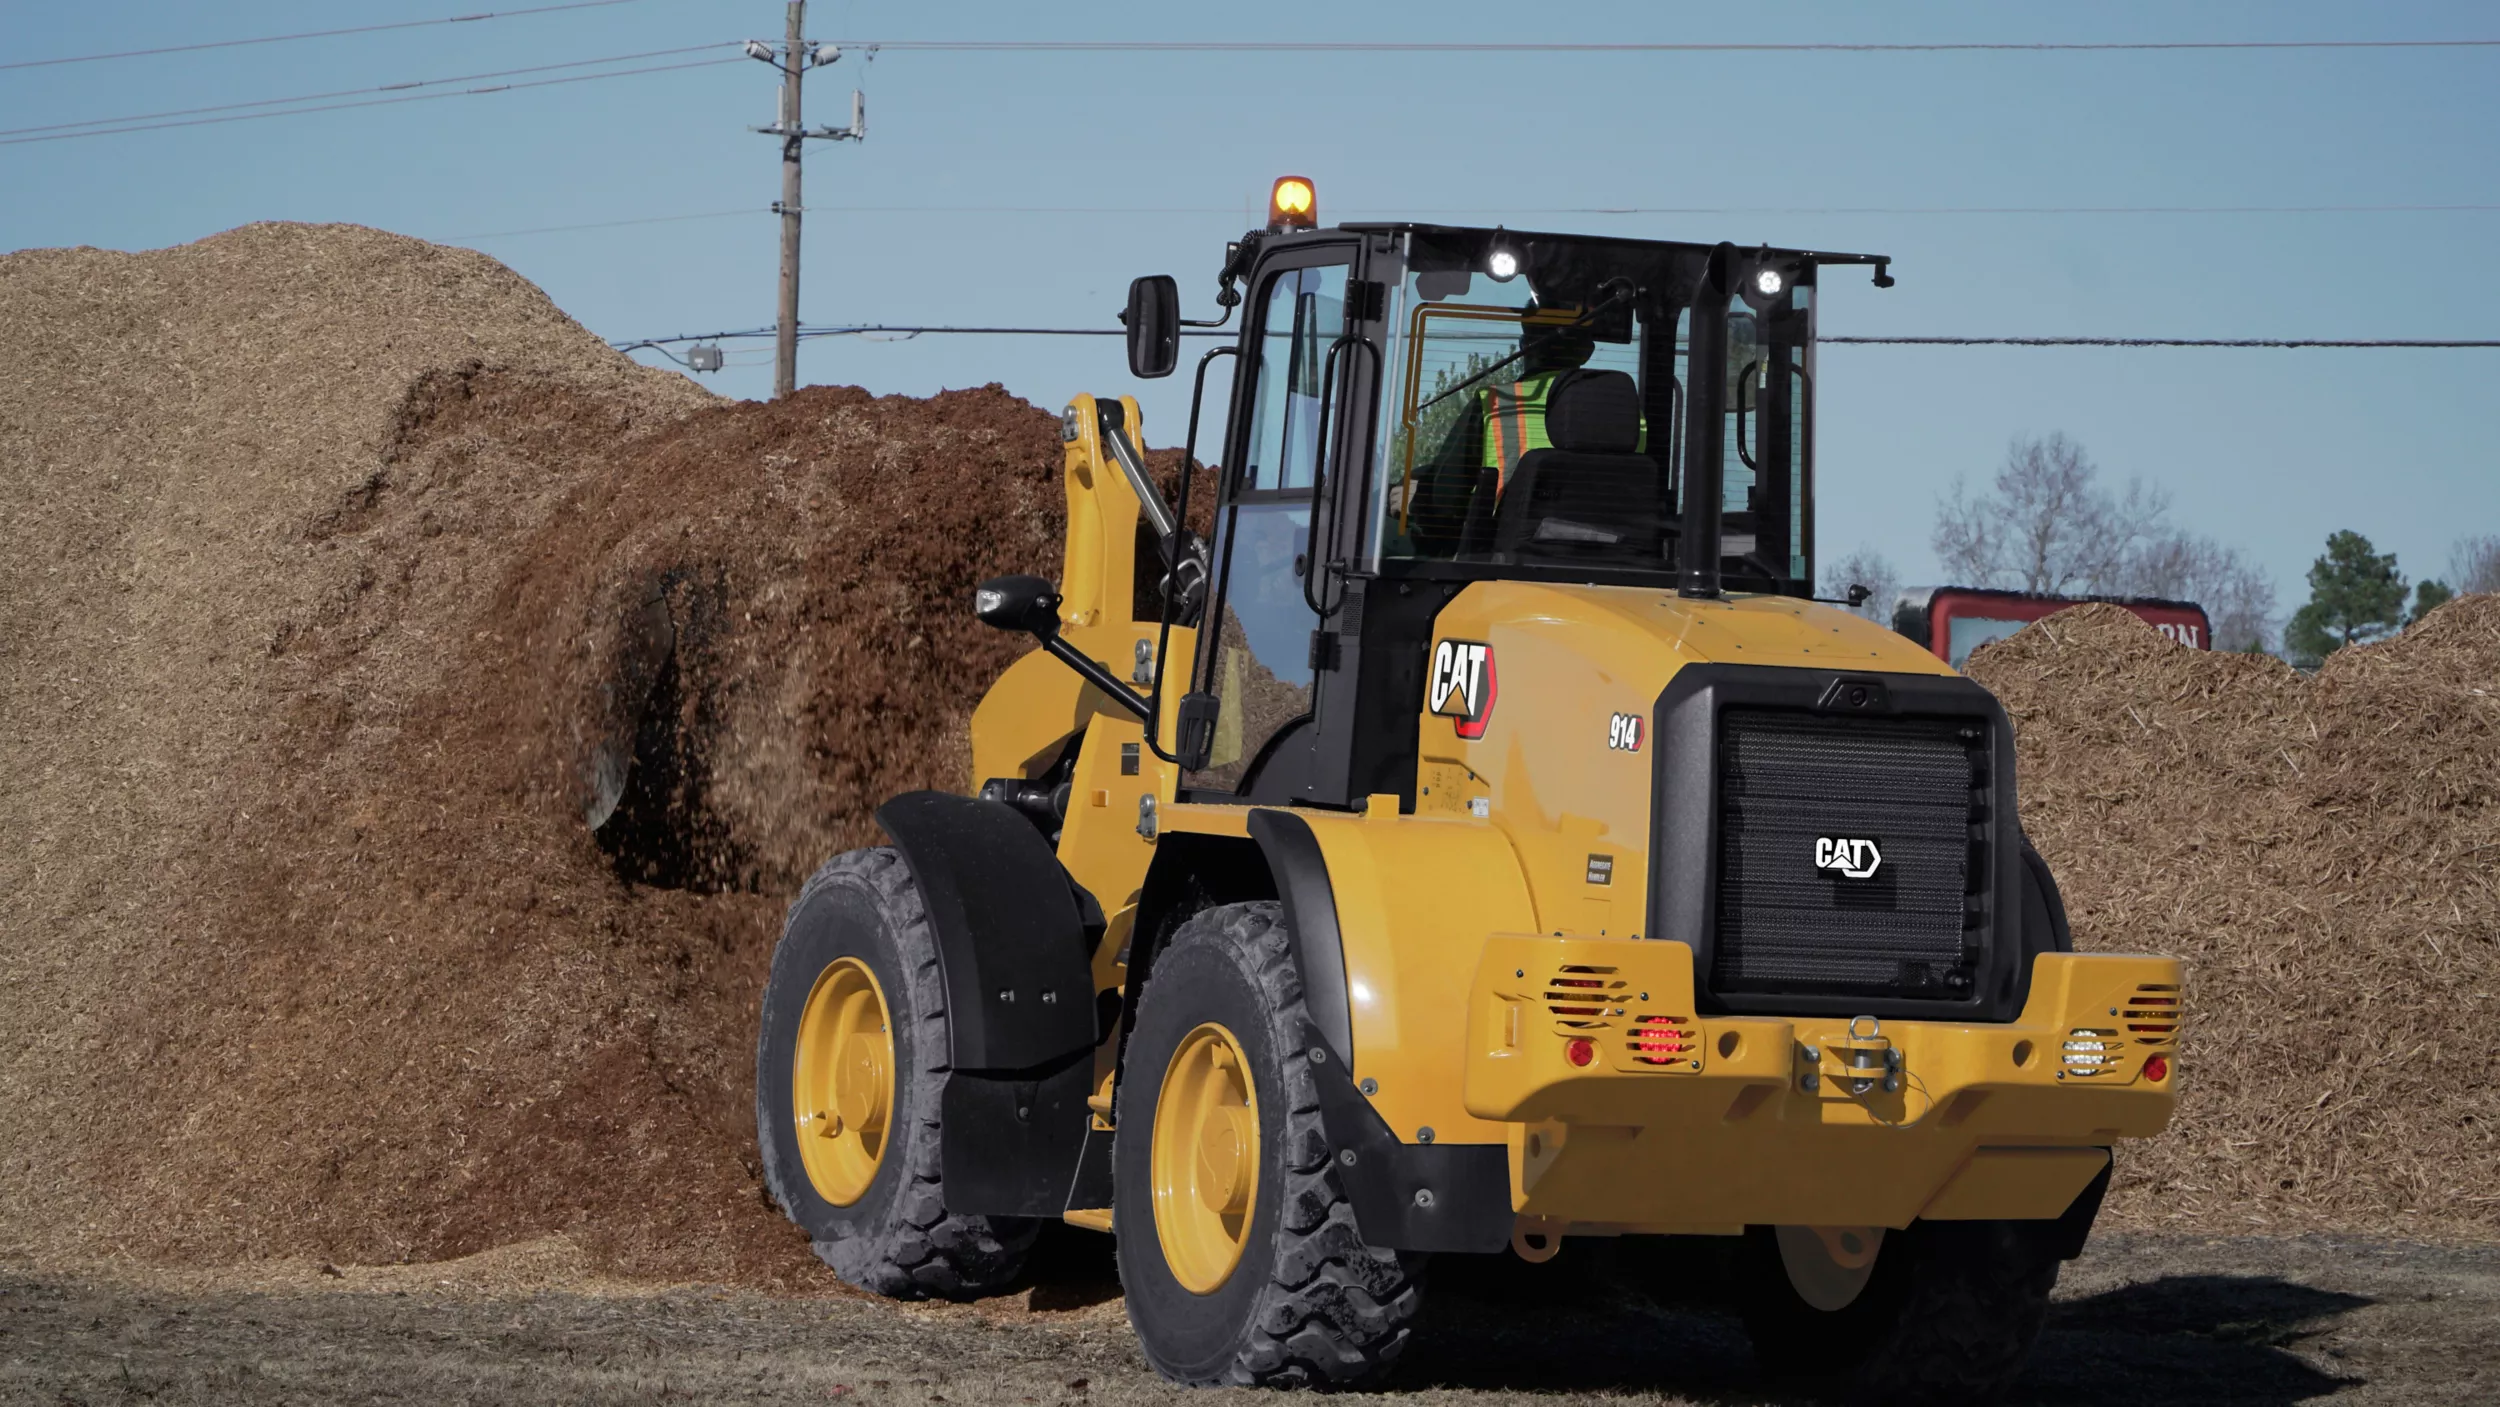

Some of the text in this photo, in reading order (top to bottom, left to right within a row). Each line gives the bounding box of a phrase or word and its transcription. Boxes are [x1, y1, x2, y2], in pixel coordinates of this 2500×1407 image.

[1430, 641, 1486, 716] CAT
[1609, 714, 1637, 750] 914
[1815, 837, 1866, 870] CAT
